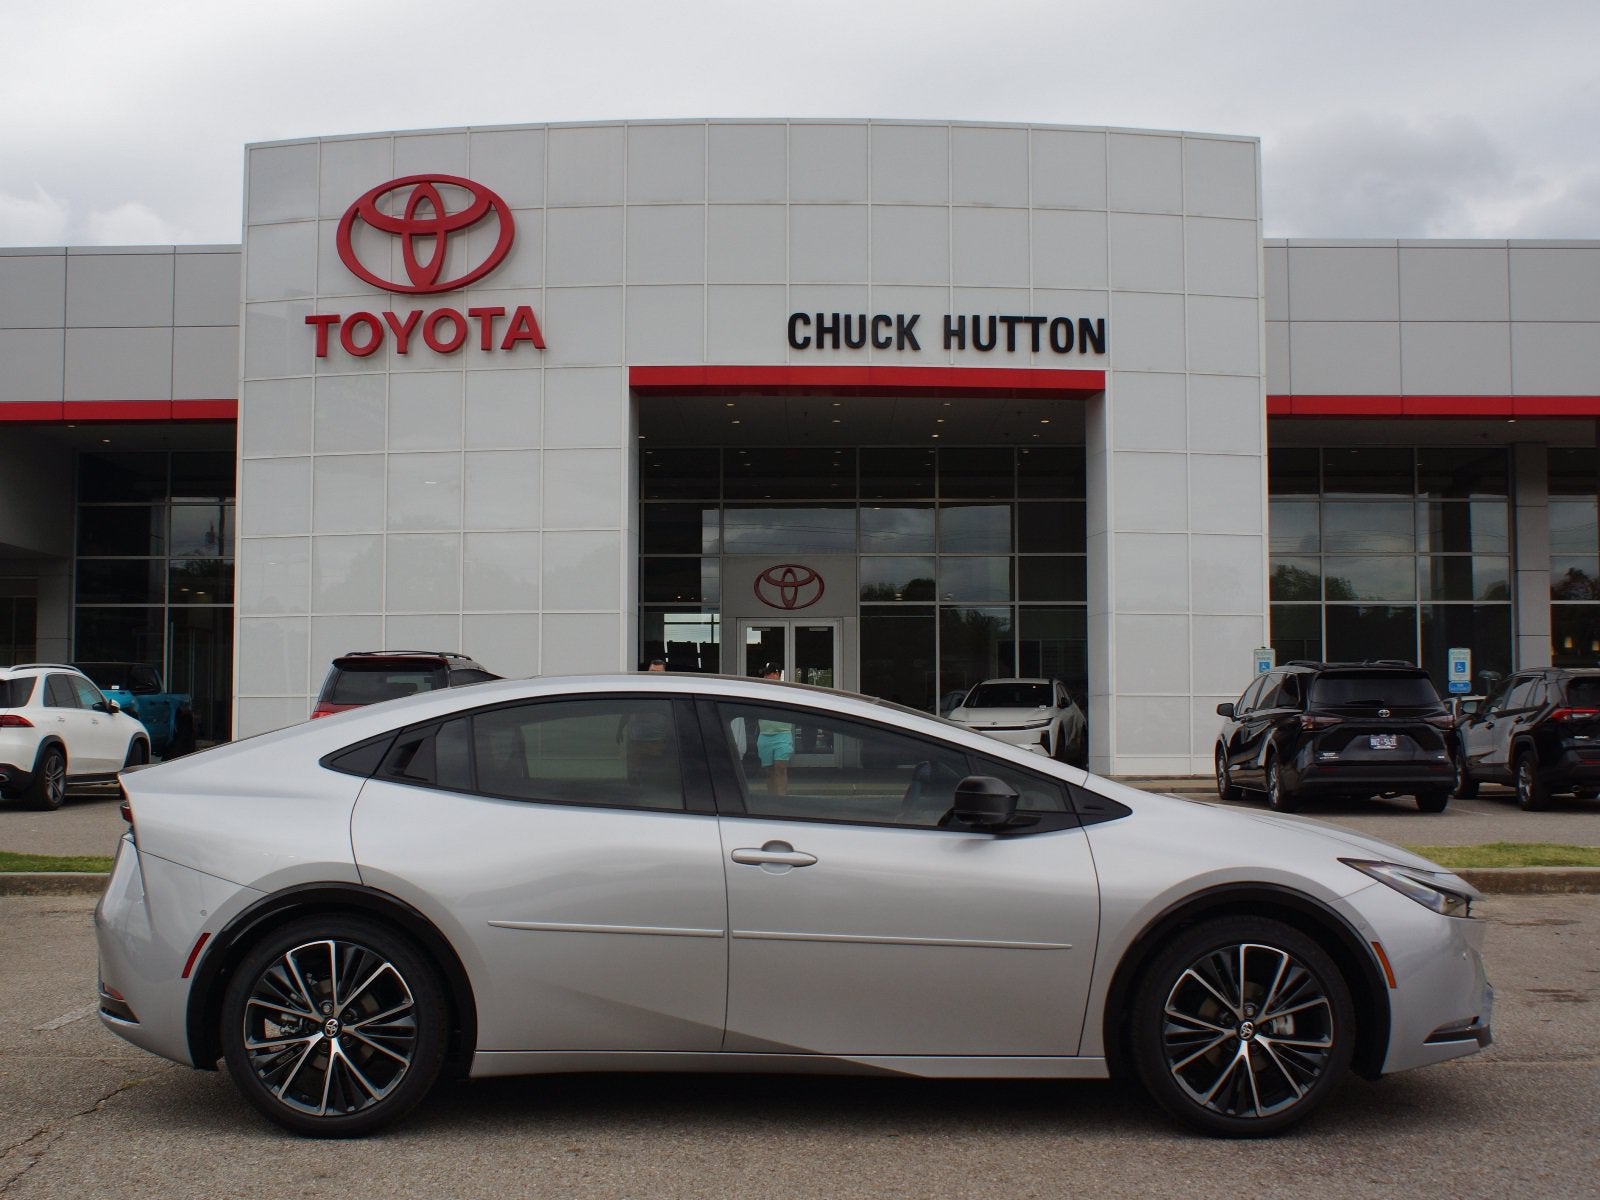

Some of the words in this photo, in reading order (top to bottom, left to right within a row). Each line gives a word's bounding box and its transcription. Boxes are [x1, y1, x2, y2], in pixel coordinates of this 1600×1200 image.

[305, 305, 546, 357] TOYOTA
[788, 312, 921, 351] CHUCK
[944, 314, 1106, 354] HUTTON
